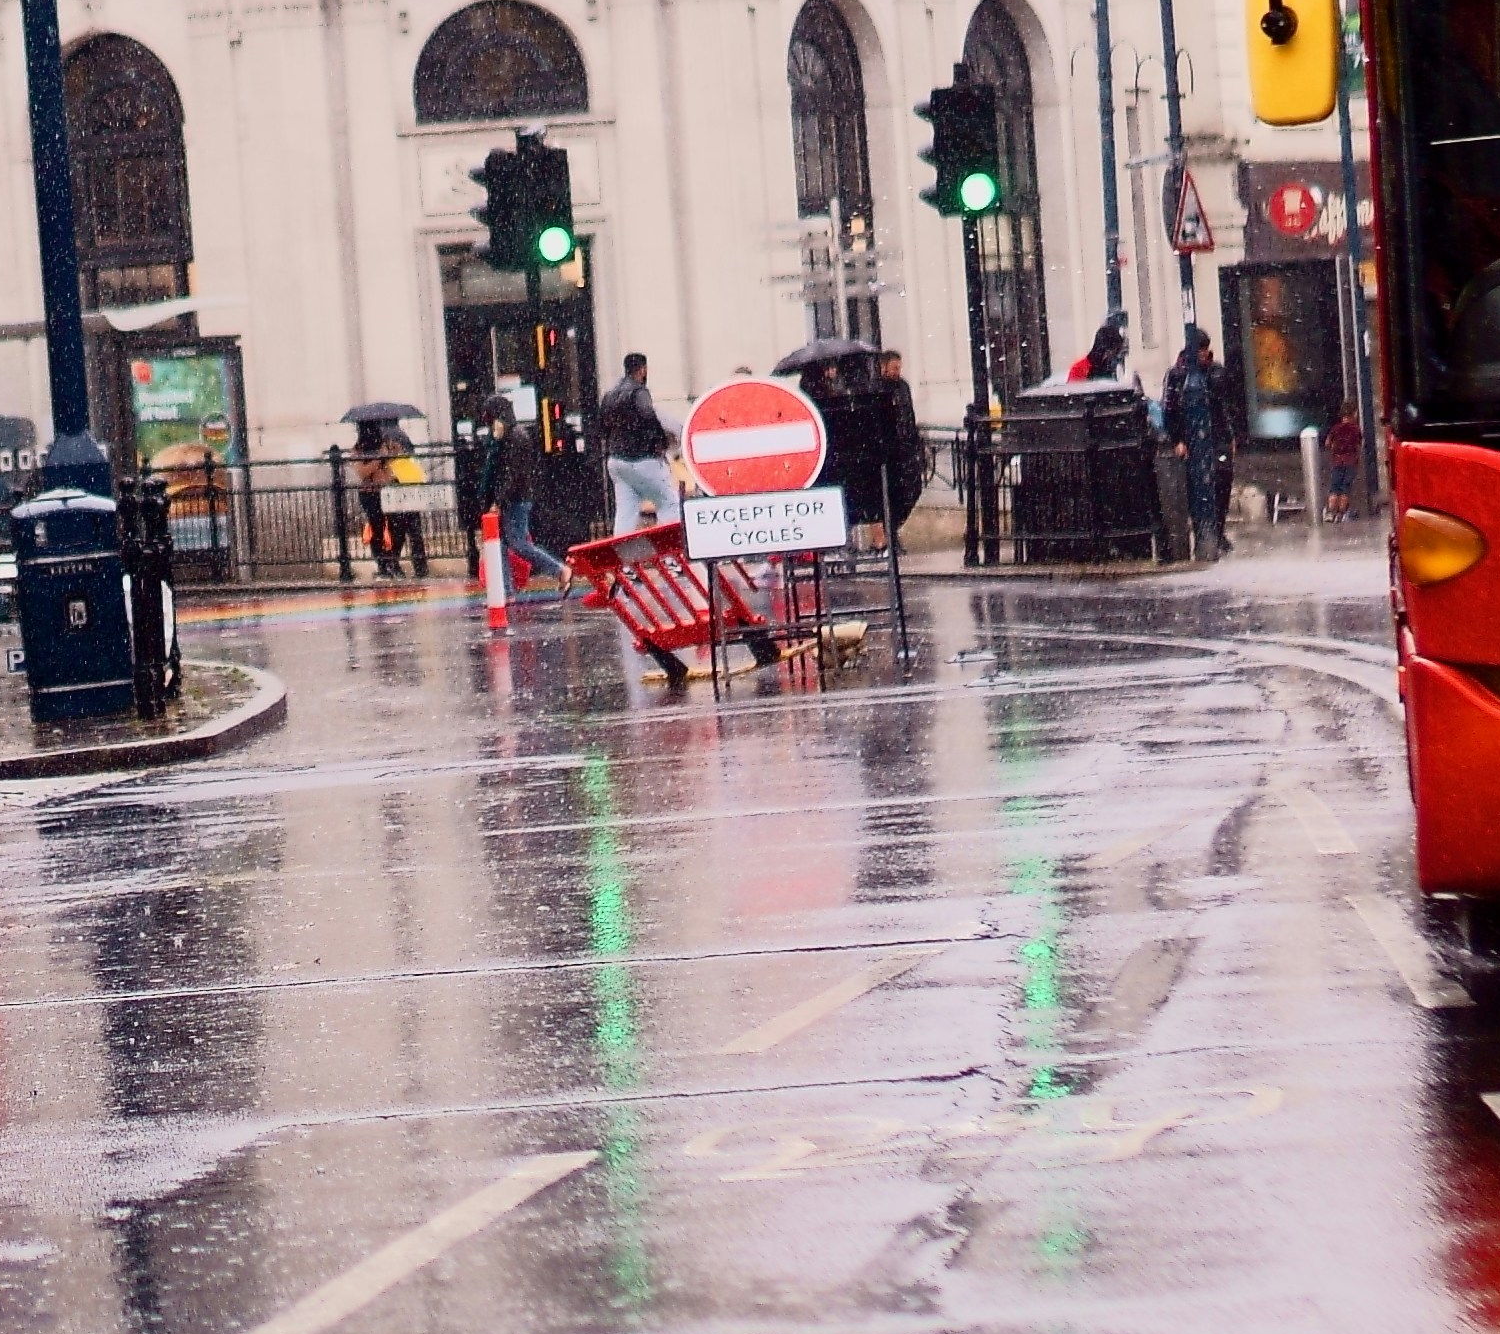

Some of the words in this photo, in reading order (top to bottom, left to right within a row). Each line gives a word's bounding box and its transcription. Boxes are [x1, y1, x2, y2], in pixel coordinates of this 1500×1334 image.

[696, 504, 775, 525] EXCEPT
[784, 501, 826, 518] FOR
[730, 526, 805, 546] CYCLES
